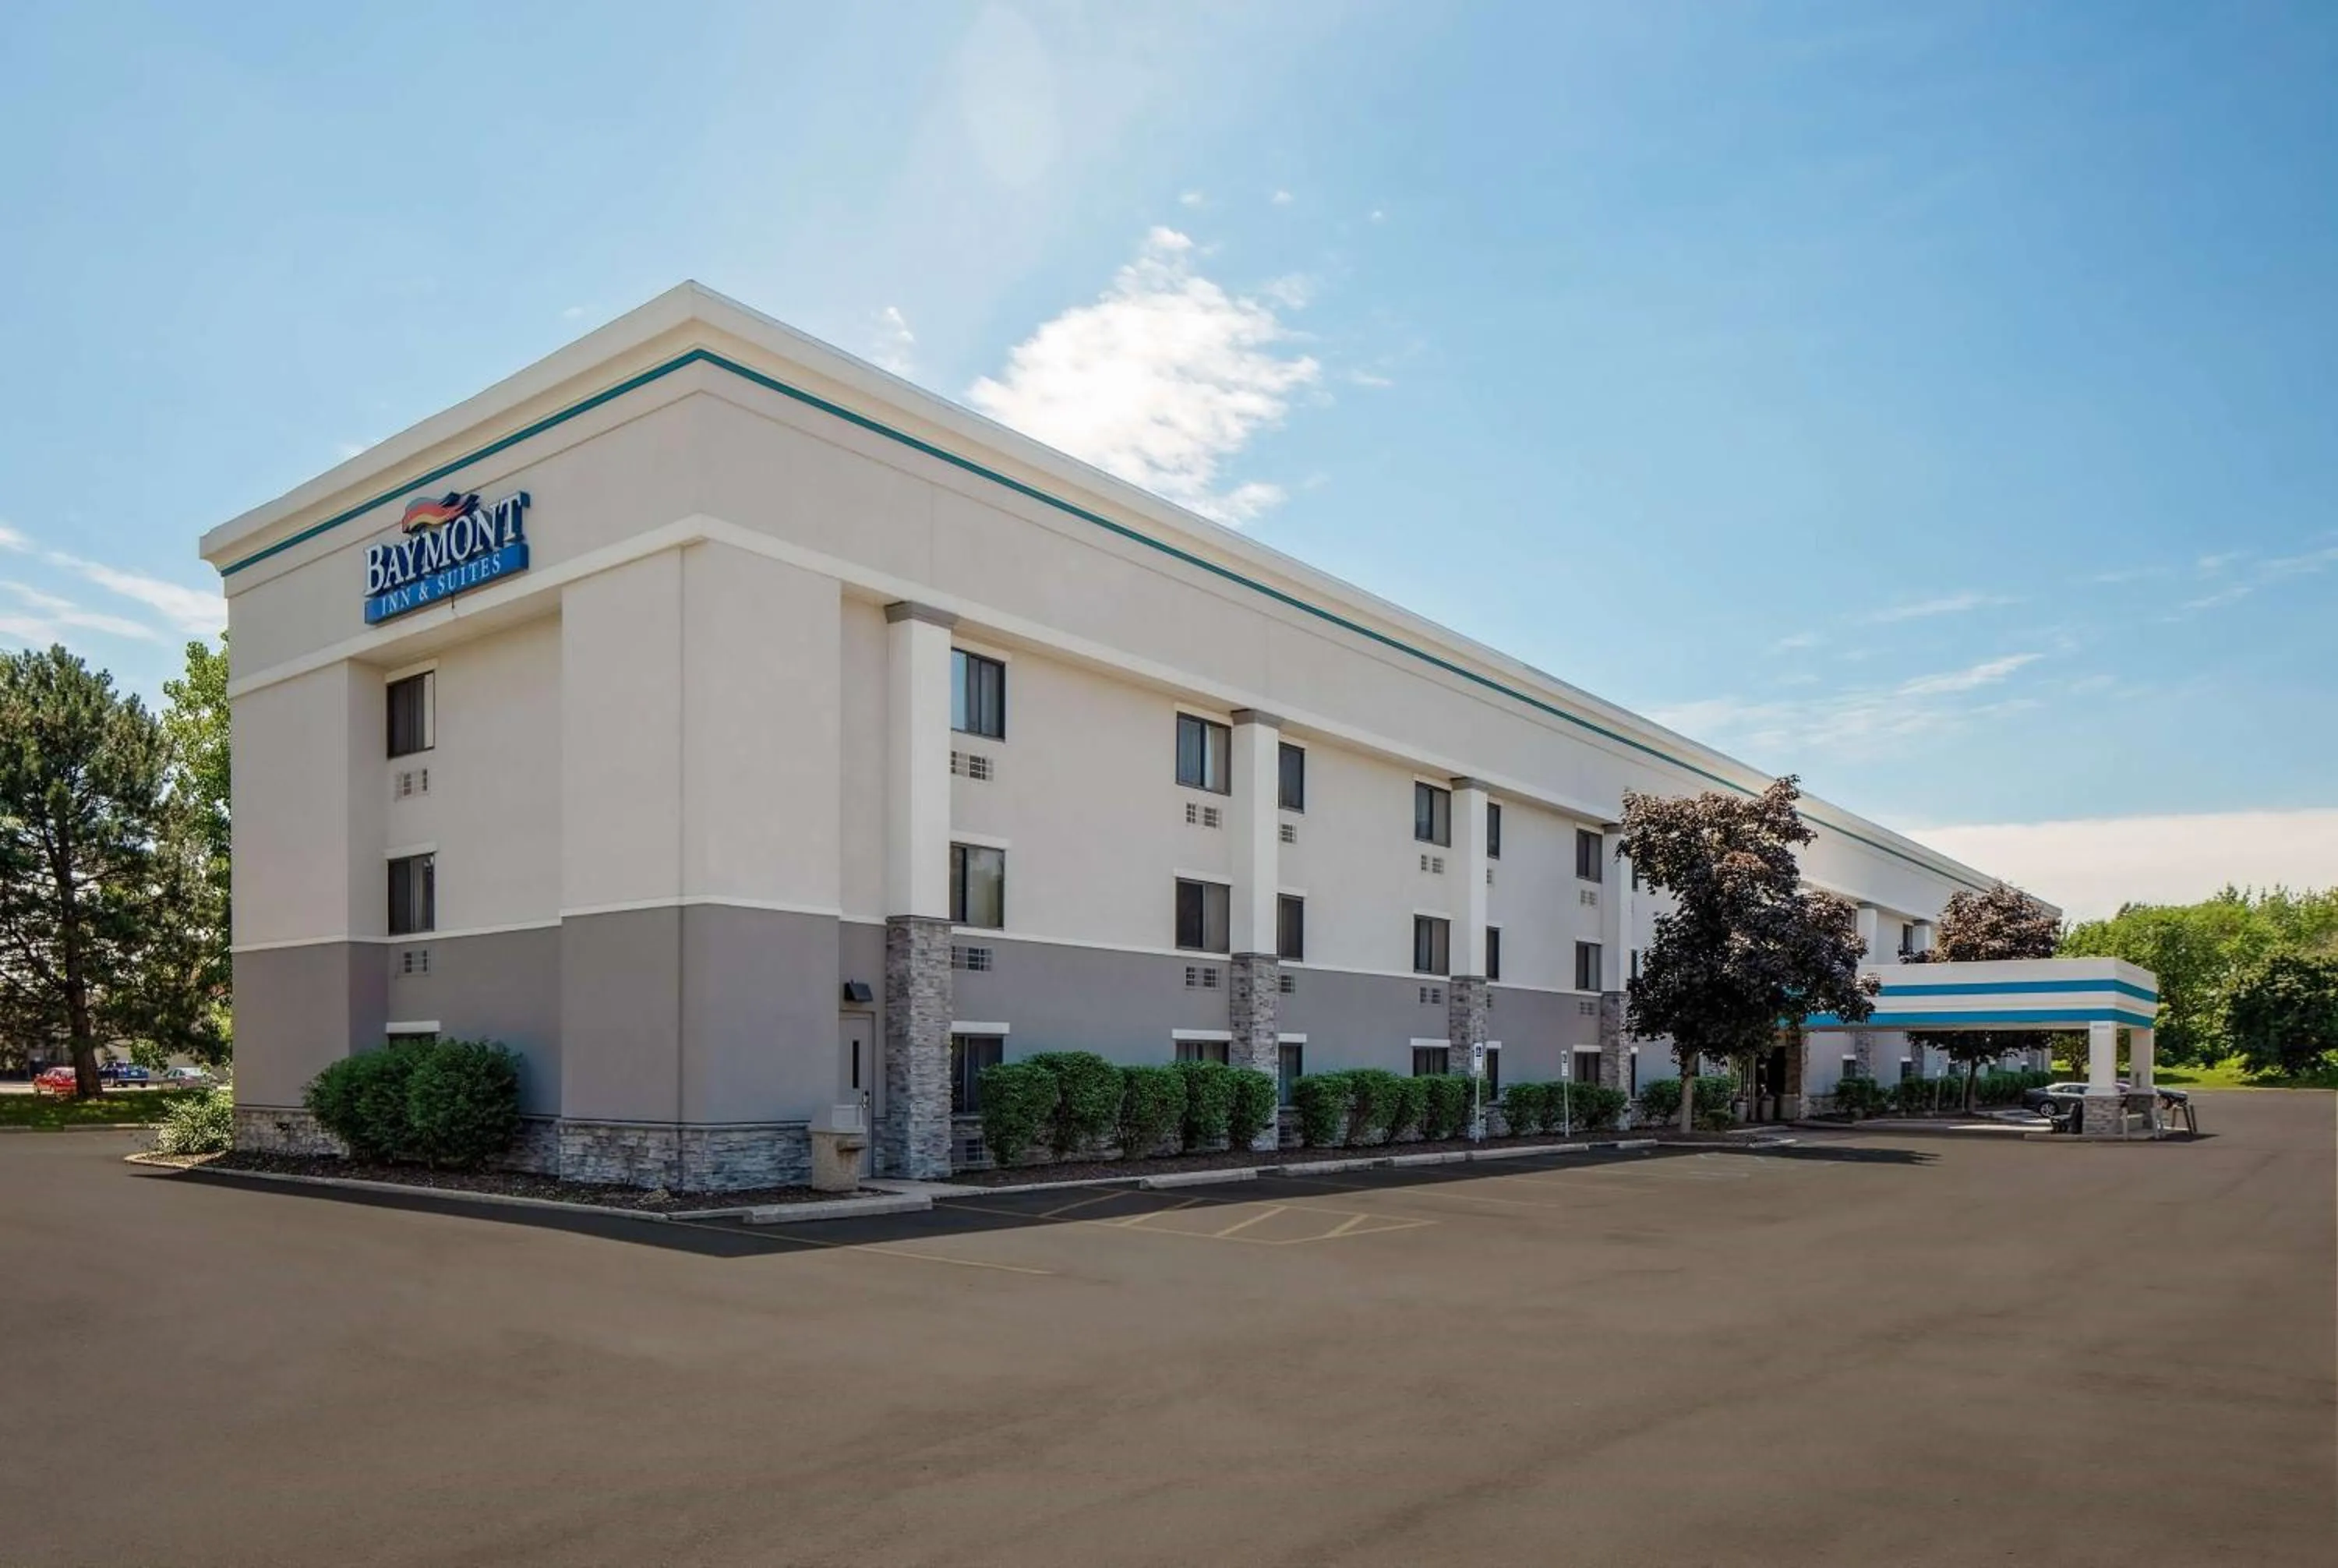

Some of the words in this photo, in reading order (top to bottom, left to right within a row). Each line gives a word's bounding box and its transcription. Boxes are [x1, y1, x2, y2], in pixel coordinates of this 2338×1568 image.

[364, 492, 524, 597] BAYMONT
[381, 587, 412, 615] INN
[419, 581, 429, 601] &
[437, 553, 501, 594] SUITES
